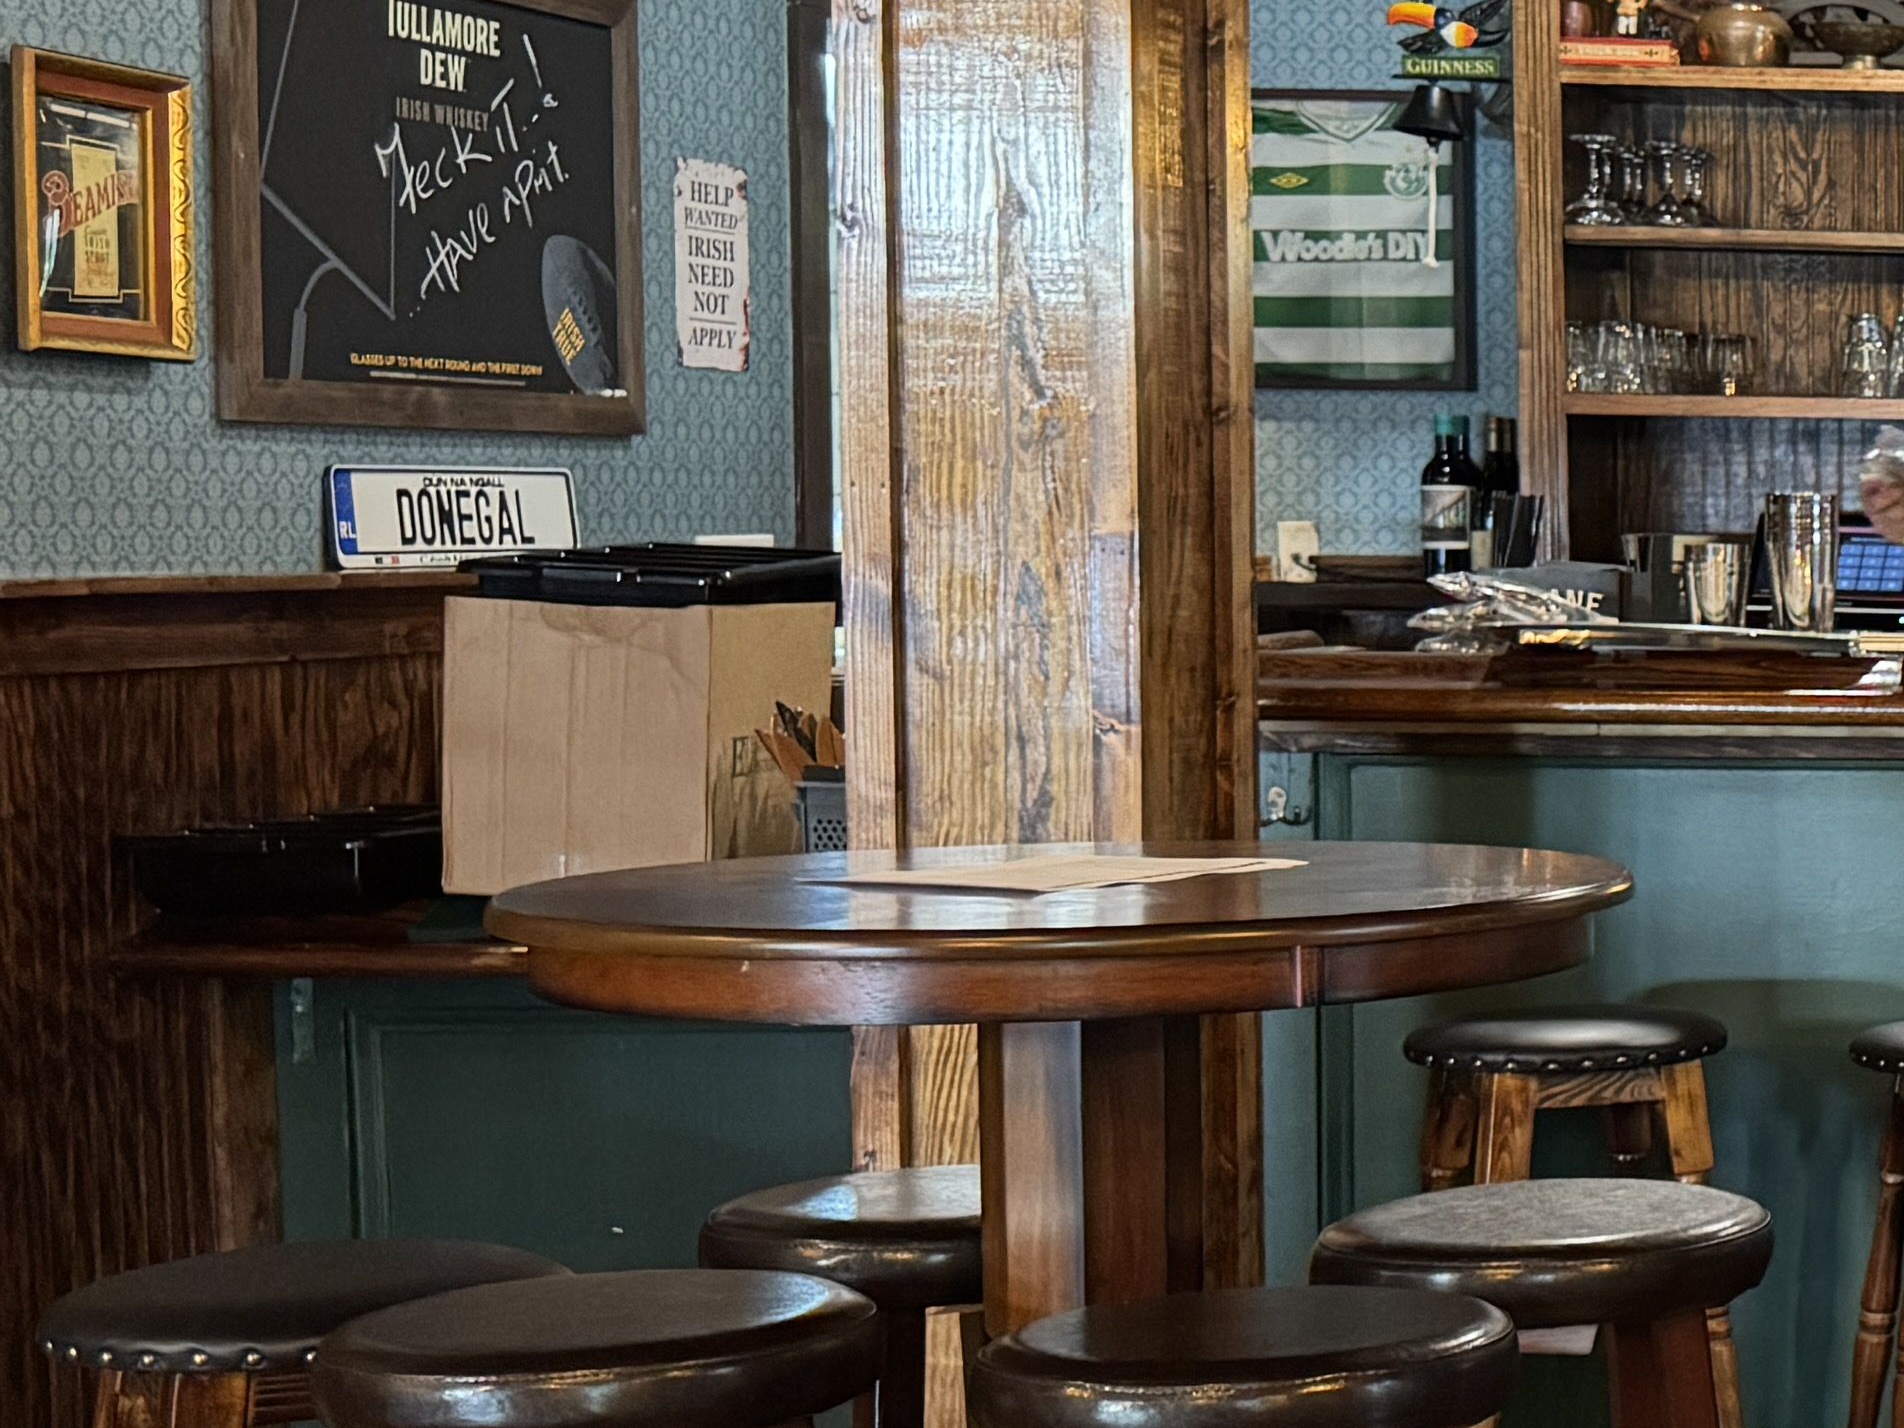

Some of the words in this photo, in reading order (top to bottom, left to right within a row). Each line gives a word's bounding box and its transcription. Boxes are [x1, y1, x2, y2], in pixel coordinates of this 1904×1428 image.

[1405, 57, 1496, 75] GUINNESS
[396, 96, 431, 123] IRISH
[434, 103, 489, 132] WHISKEY
[690, 180, 735, 208] HELP
[683, 205, 739, 230] WANTED
[688, 235, 736, 262] IRISH
[1260, 231, 1385, 263] Woodie's
[688, 263, 735, 289] NEED
[693, 290, 730, 316] NOT
[559, 307, 586, 352] IRISH
[688, 326, 738, 350] APPLY
[552, 323, 578, 366] TRUE
[385, 355, 396, 366] UP
[397, 355, 408, 368] TO
[450, 477, 466, 488] NA
[396, 488, 536, 546] DONEGAL
